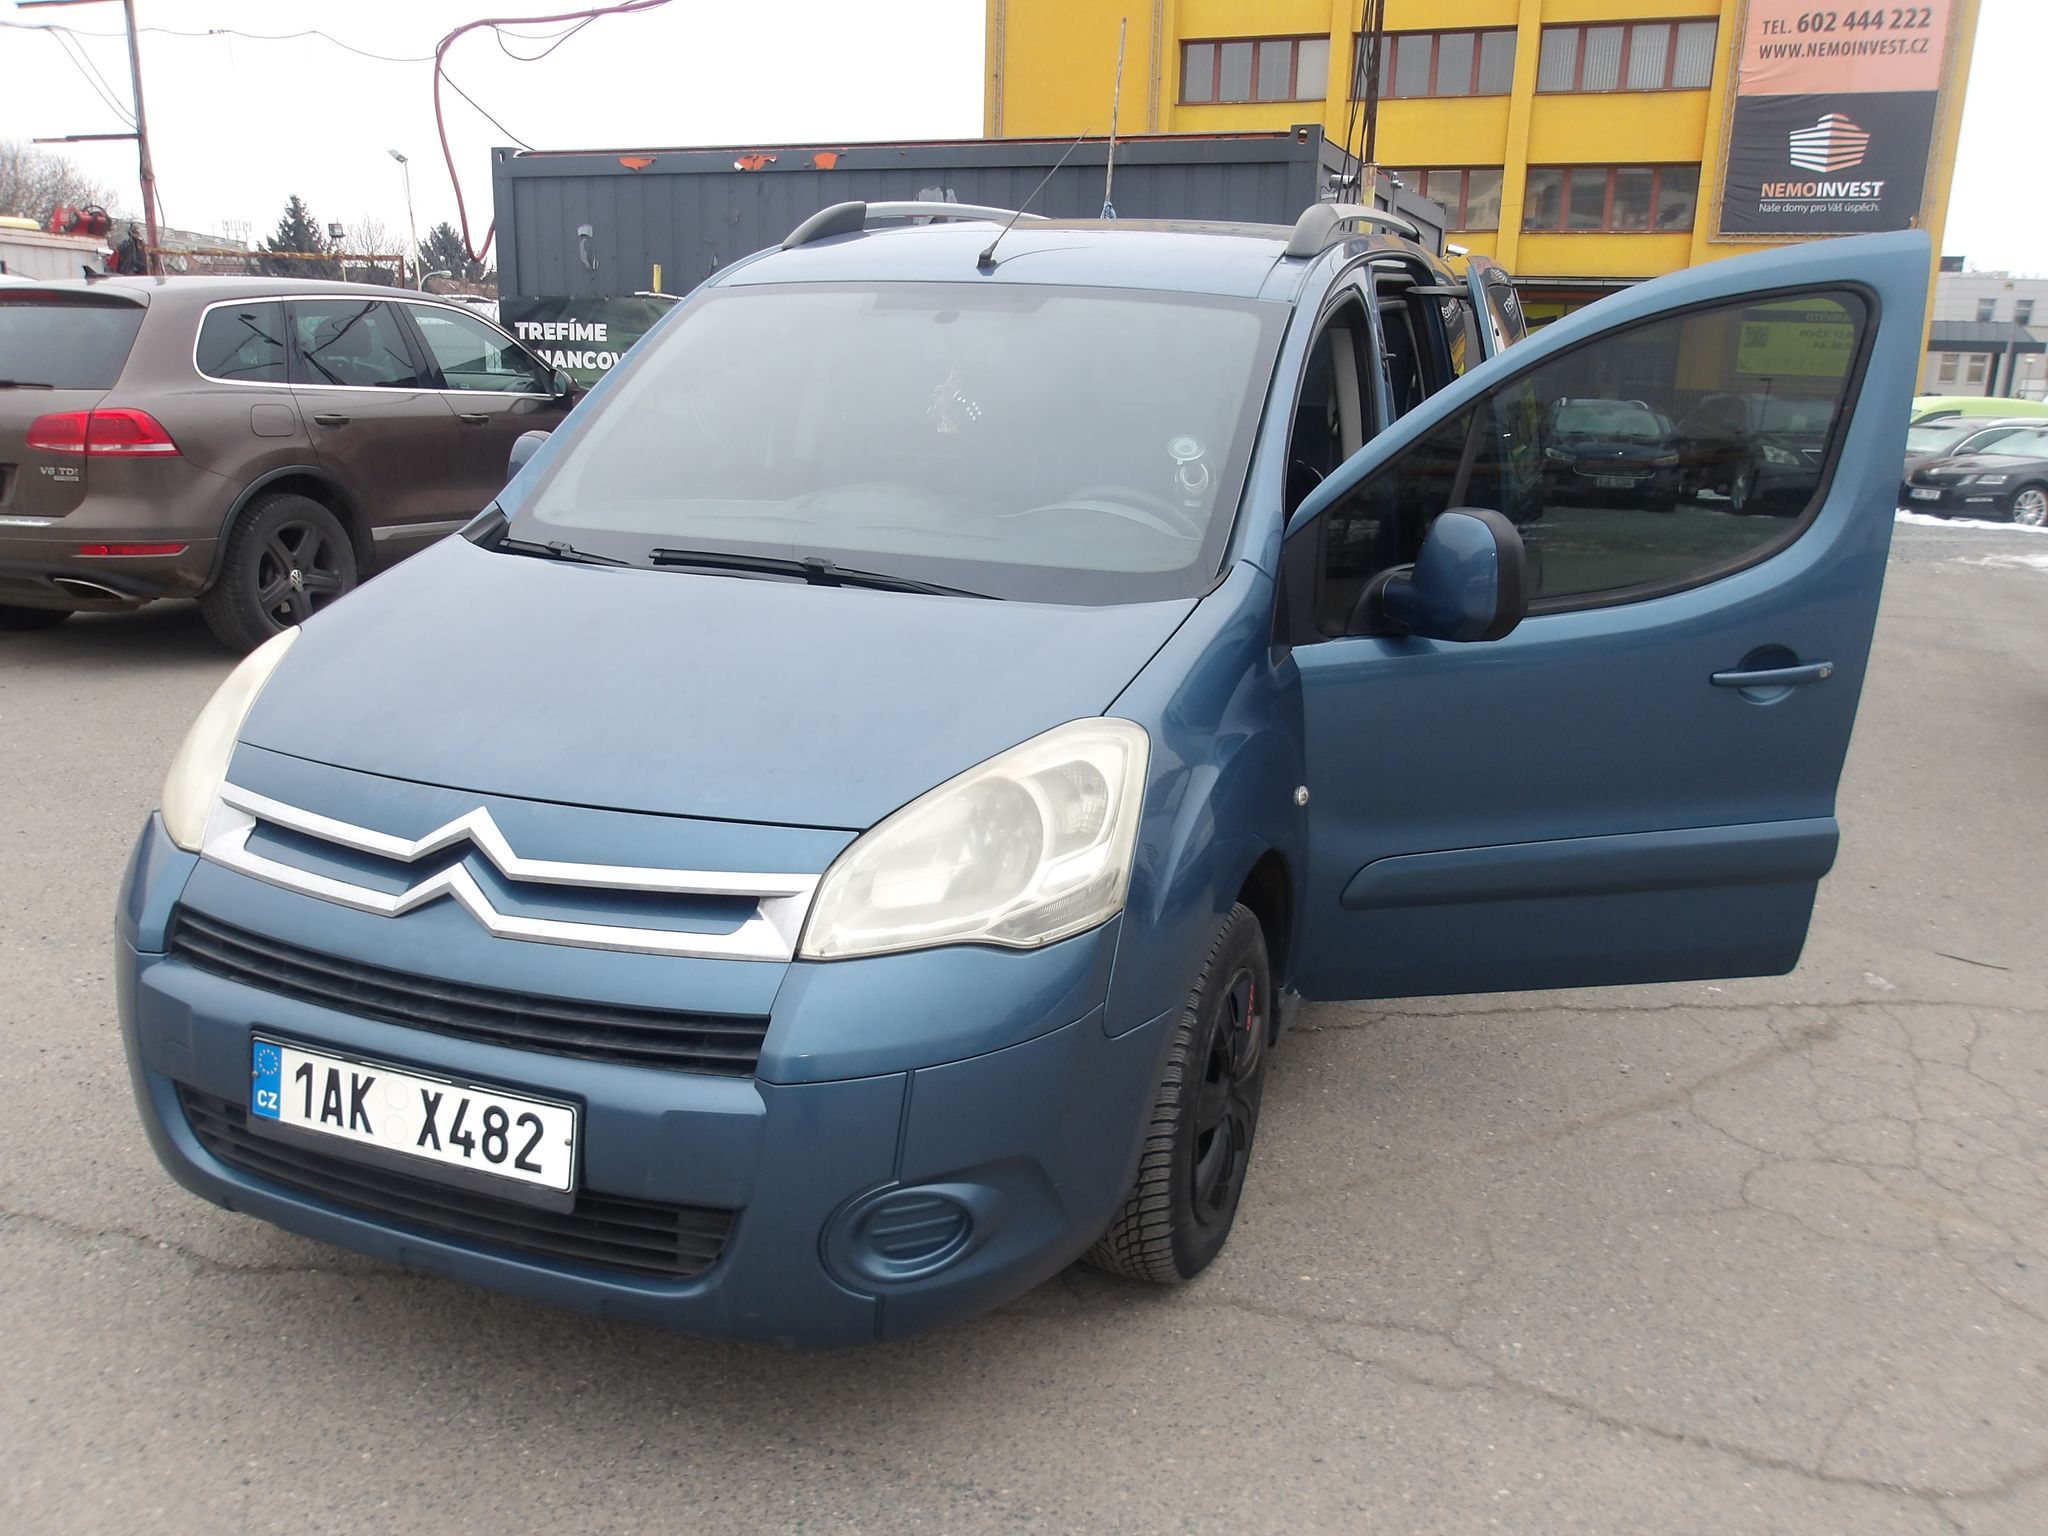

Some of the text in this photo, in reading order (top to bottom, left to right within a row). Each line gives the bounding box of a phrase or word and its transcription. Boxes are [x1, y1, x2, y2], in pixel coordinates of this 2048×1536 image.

[1762, 7, 1932, 36] TEL. 602 444 222
[1759, 38, 1930, 60] WWW.NEMOINVEST.CZ
[1760, 181, 1884, 198] NEMOINVEST
[1758, 202, 1880, 214] Naše domy pro Váš úspěch.
[514, 318, 608, 342] TREFÍME
[40, 467, 55, 475] V6
[257, 1090, 278, 1110] CZ
[294, 1062, 544, 1174] 1AK X482
